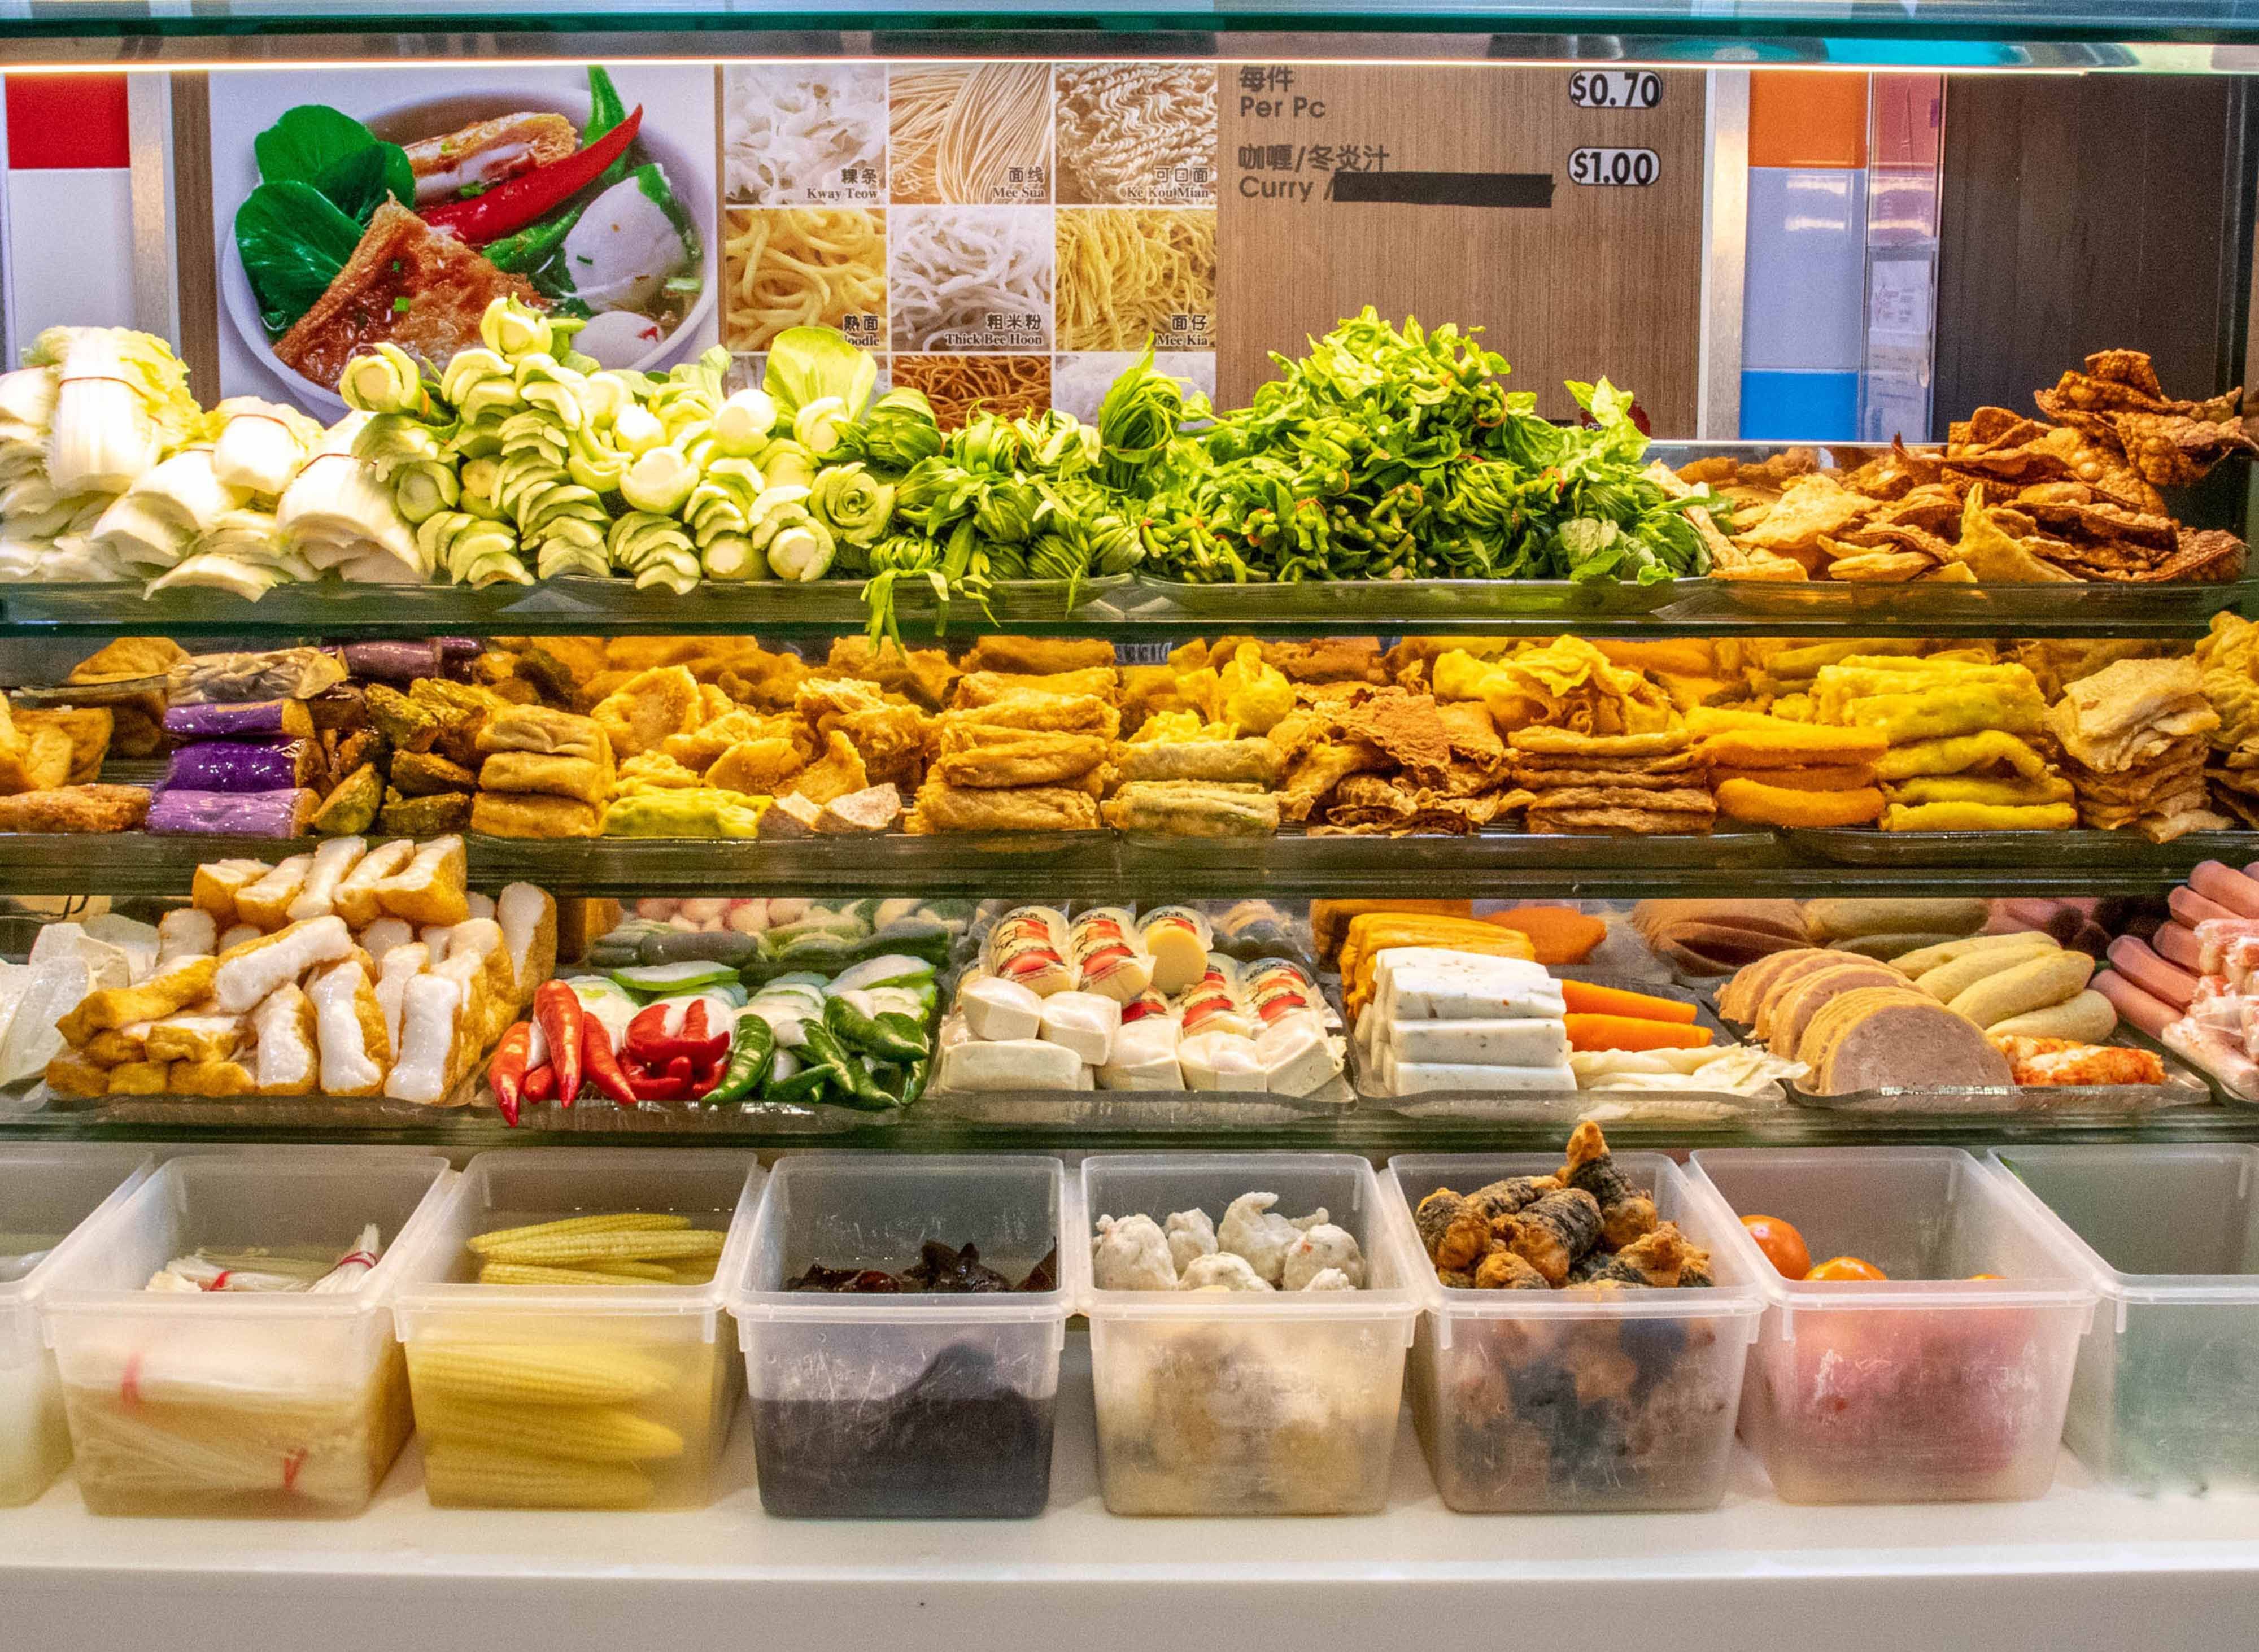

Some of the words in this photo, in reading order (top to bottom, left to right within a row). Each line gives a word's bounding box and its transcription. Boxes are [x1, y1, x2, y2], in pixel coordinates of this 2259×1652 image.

[1239, 65, 1294, 92] 每件
[1572, 72, 1660, 107] $0.70
[1241, 96, 1283, 117] Per
[1293, 96, 1325, 118] Pc
[1009, 167, 1043, 183] 面线
[1573, 151, 1652, 184] $1.00
[1155, 168, 1208, 183] 可口面
[807, 188, 840, 201] Kway
[845, 188, 877, 198] Teow
[993, 187, 1018, 198] Mee
[1022, 187, 1044, 198] Sua
[1127, 186, 1144, 198] Ke
[1149, 186, 1174, 198] Kou
[1178, 186, 1209, 198] Mian
[1239, 176, 1313, 202] Curry
[987, 313, 1041, 330] 粗米粉
[1172, 315, 1207, 330] 面仔
[945, 334, 980, 345] Thick
[985, 334, 1006, 345] Bee
[1010, 334, 1042, 345] Hoon
[1157, 335, 1183, 345] Mee
[1187, 334, 1207, 345] Kia
